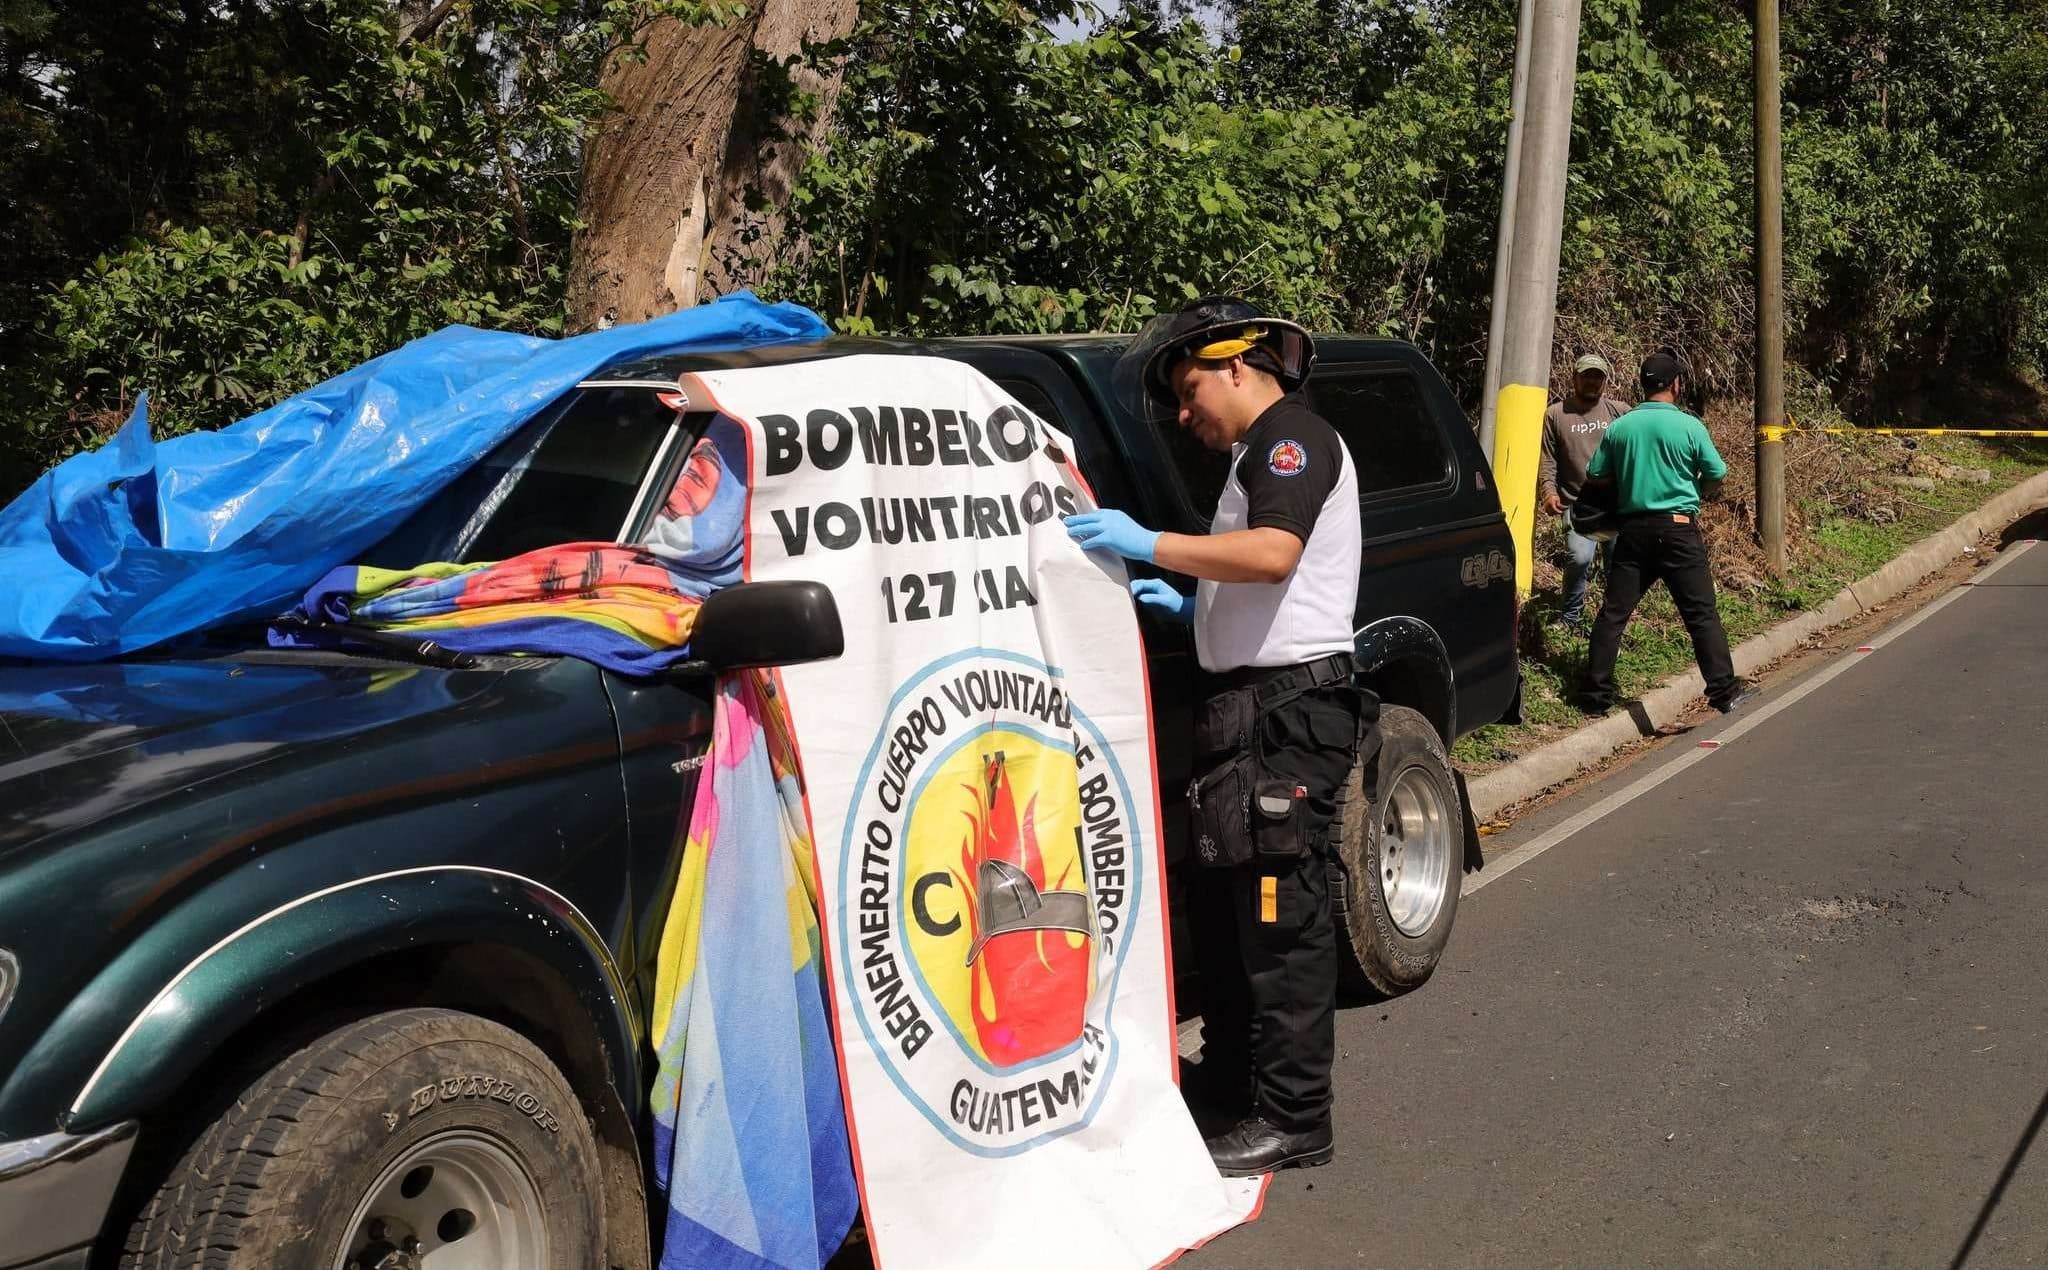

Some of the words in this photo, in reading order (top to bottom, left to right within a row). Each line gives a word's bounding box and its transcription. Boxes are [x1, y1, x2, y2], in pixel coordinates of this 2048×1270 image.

[1571, 420, 1609, 434] ripple
[880, 570, 957, 623] 127
[940, 669, 1073, 730] VOUNTARI
[671, 755, 705, 774] TOYO
[878, 696, 947, 814] CUERPO
[912, 871, 962, 937] C
[860, 820, 934, 1061] BENEMERITO
[408, 1076, 561, 1133] DUNLOP
[950, 1022, 1105, 1135] GUATEMA
